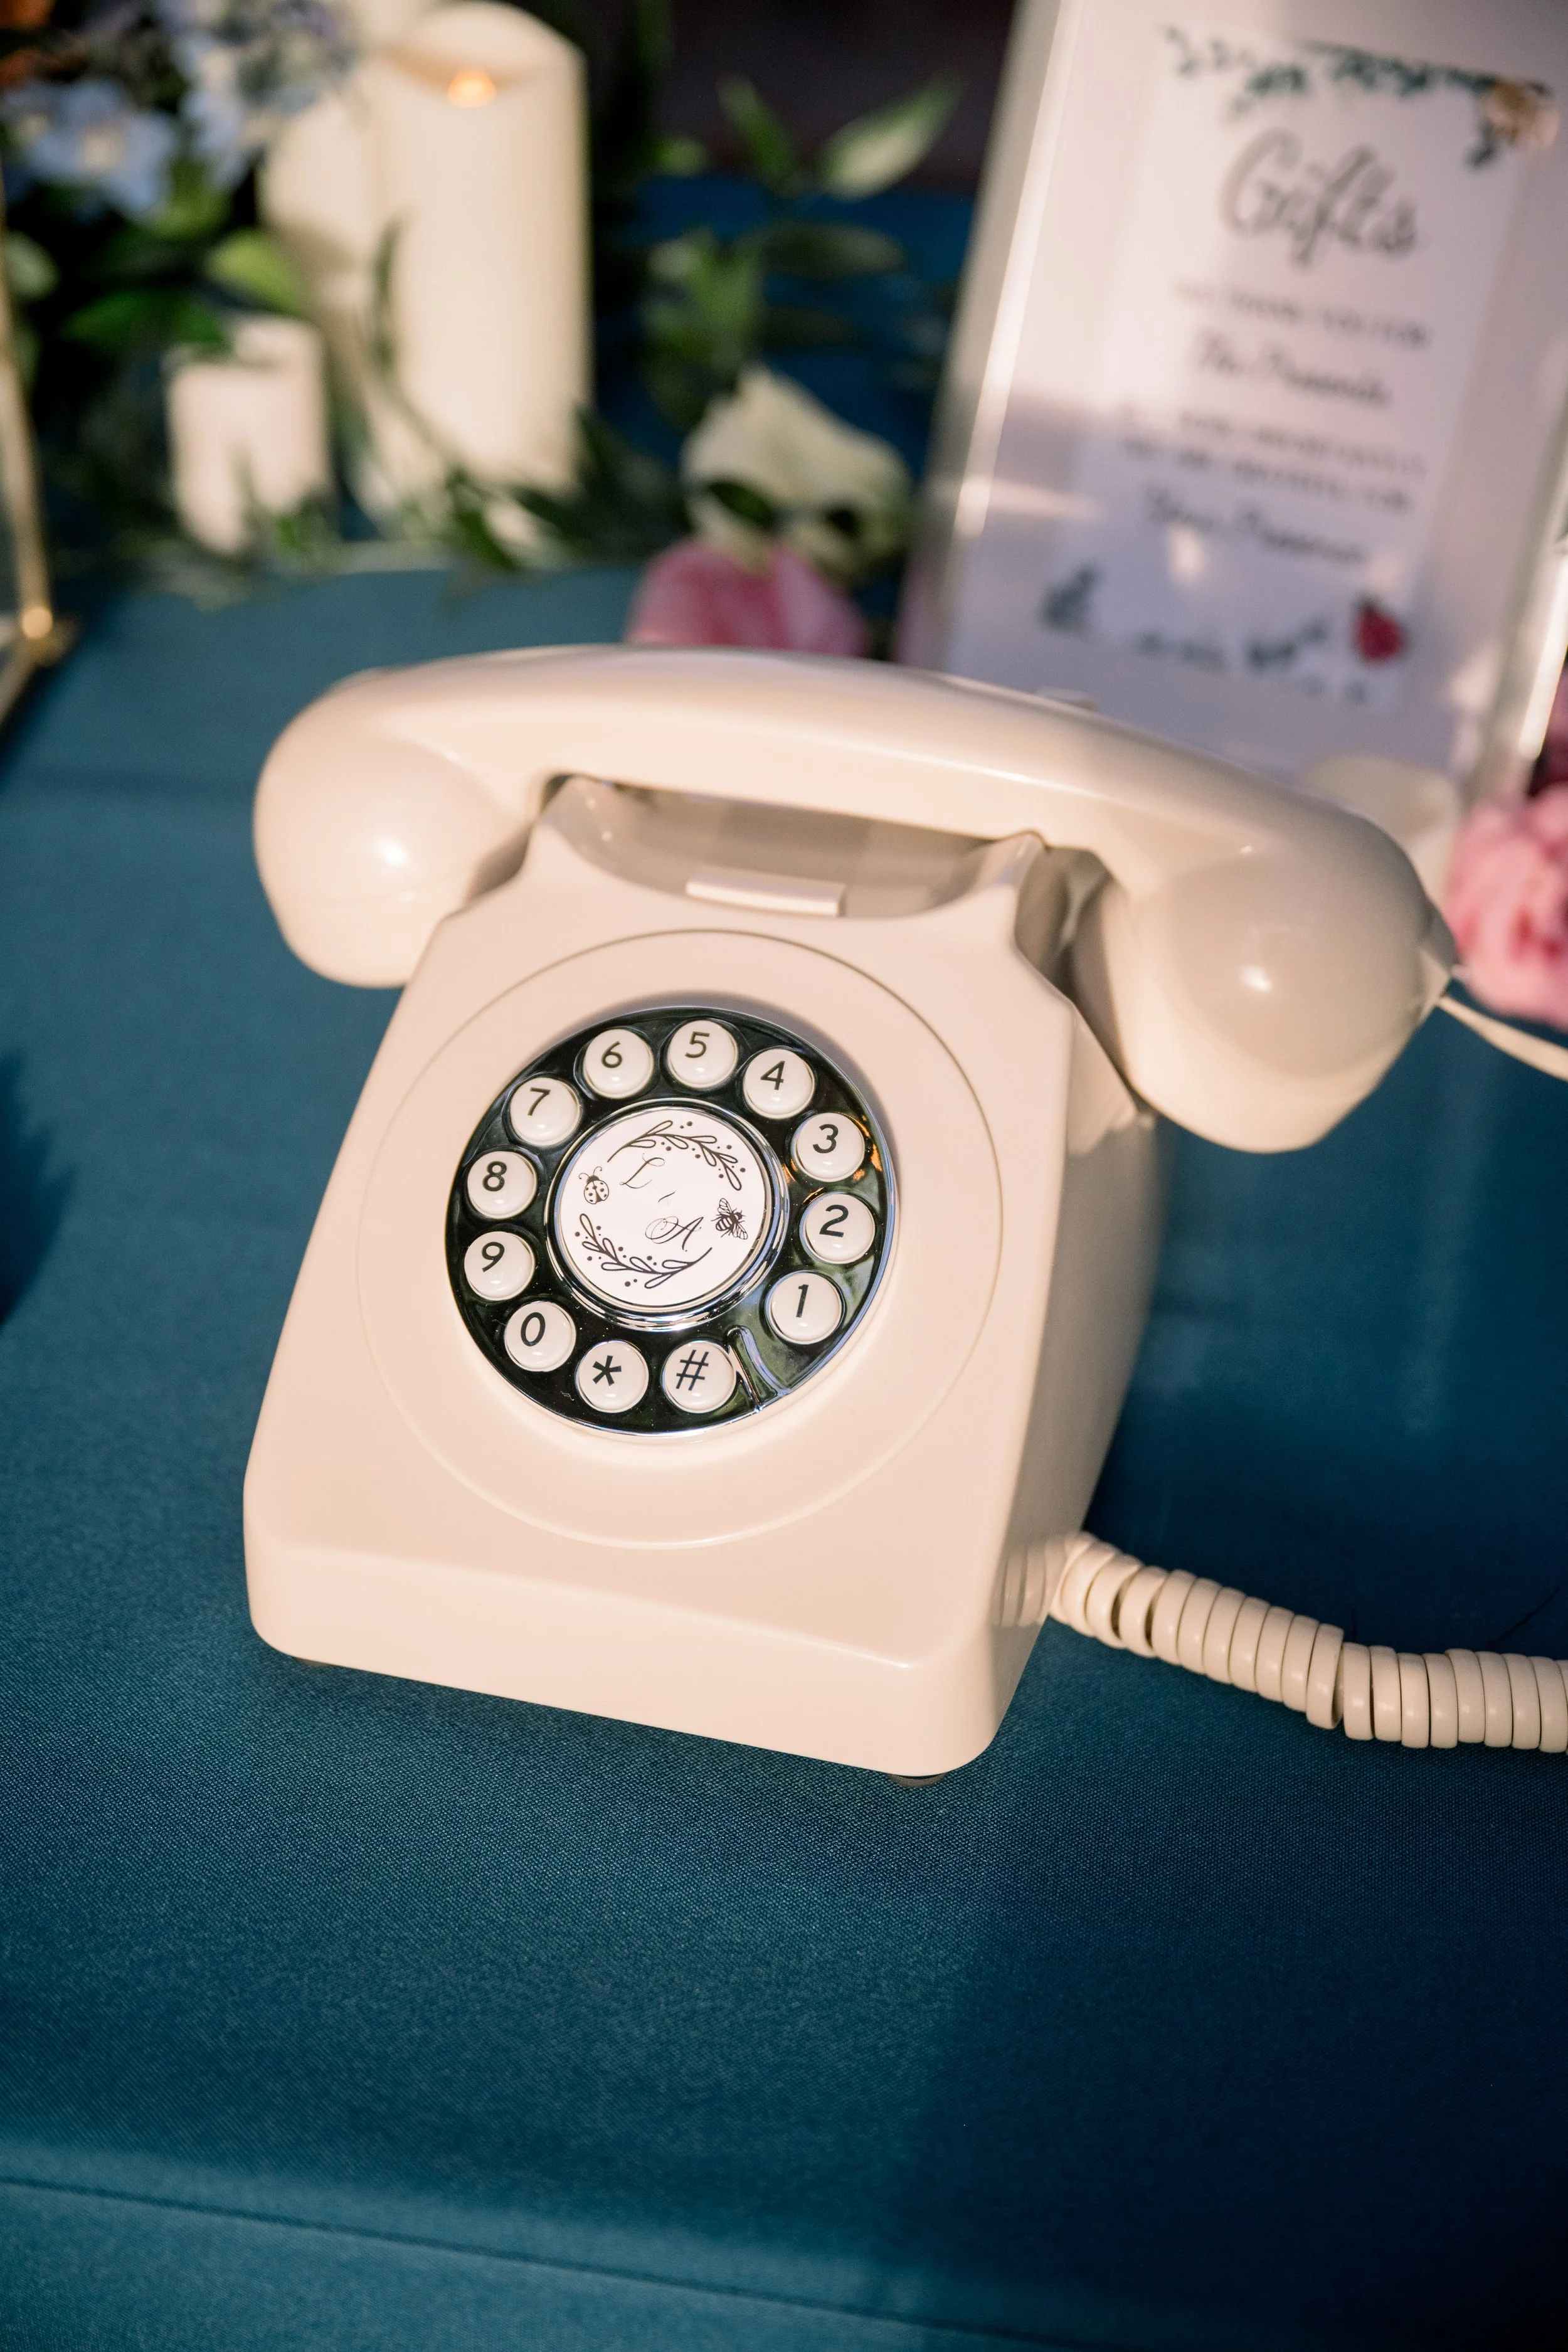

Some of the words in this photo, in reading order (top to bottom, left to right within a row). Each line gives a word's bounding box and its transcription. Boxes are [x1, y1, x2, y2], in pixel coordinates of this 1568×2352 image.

[1219, 125, 1419, 270] Gifts
[601, 1041, 622, 1068] 6
[685, 1031, 709, 1059] 5
[761, 1061, 785, 1090] 4
[527, 1087, 550, 1116] 7
[813, 1124, 839, 1153] 3
[482, 1161, 507, 1192] 8
[645, 1216, 704, 1251] A
[819, 1205, 849, 1237] 2
[481, 1241, 505, 1273] 9
[797, 1284, 808, 1318] 1
[521, 1312, 546, 1347] 0
[676, 1350, 709, 1391] #
